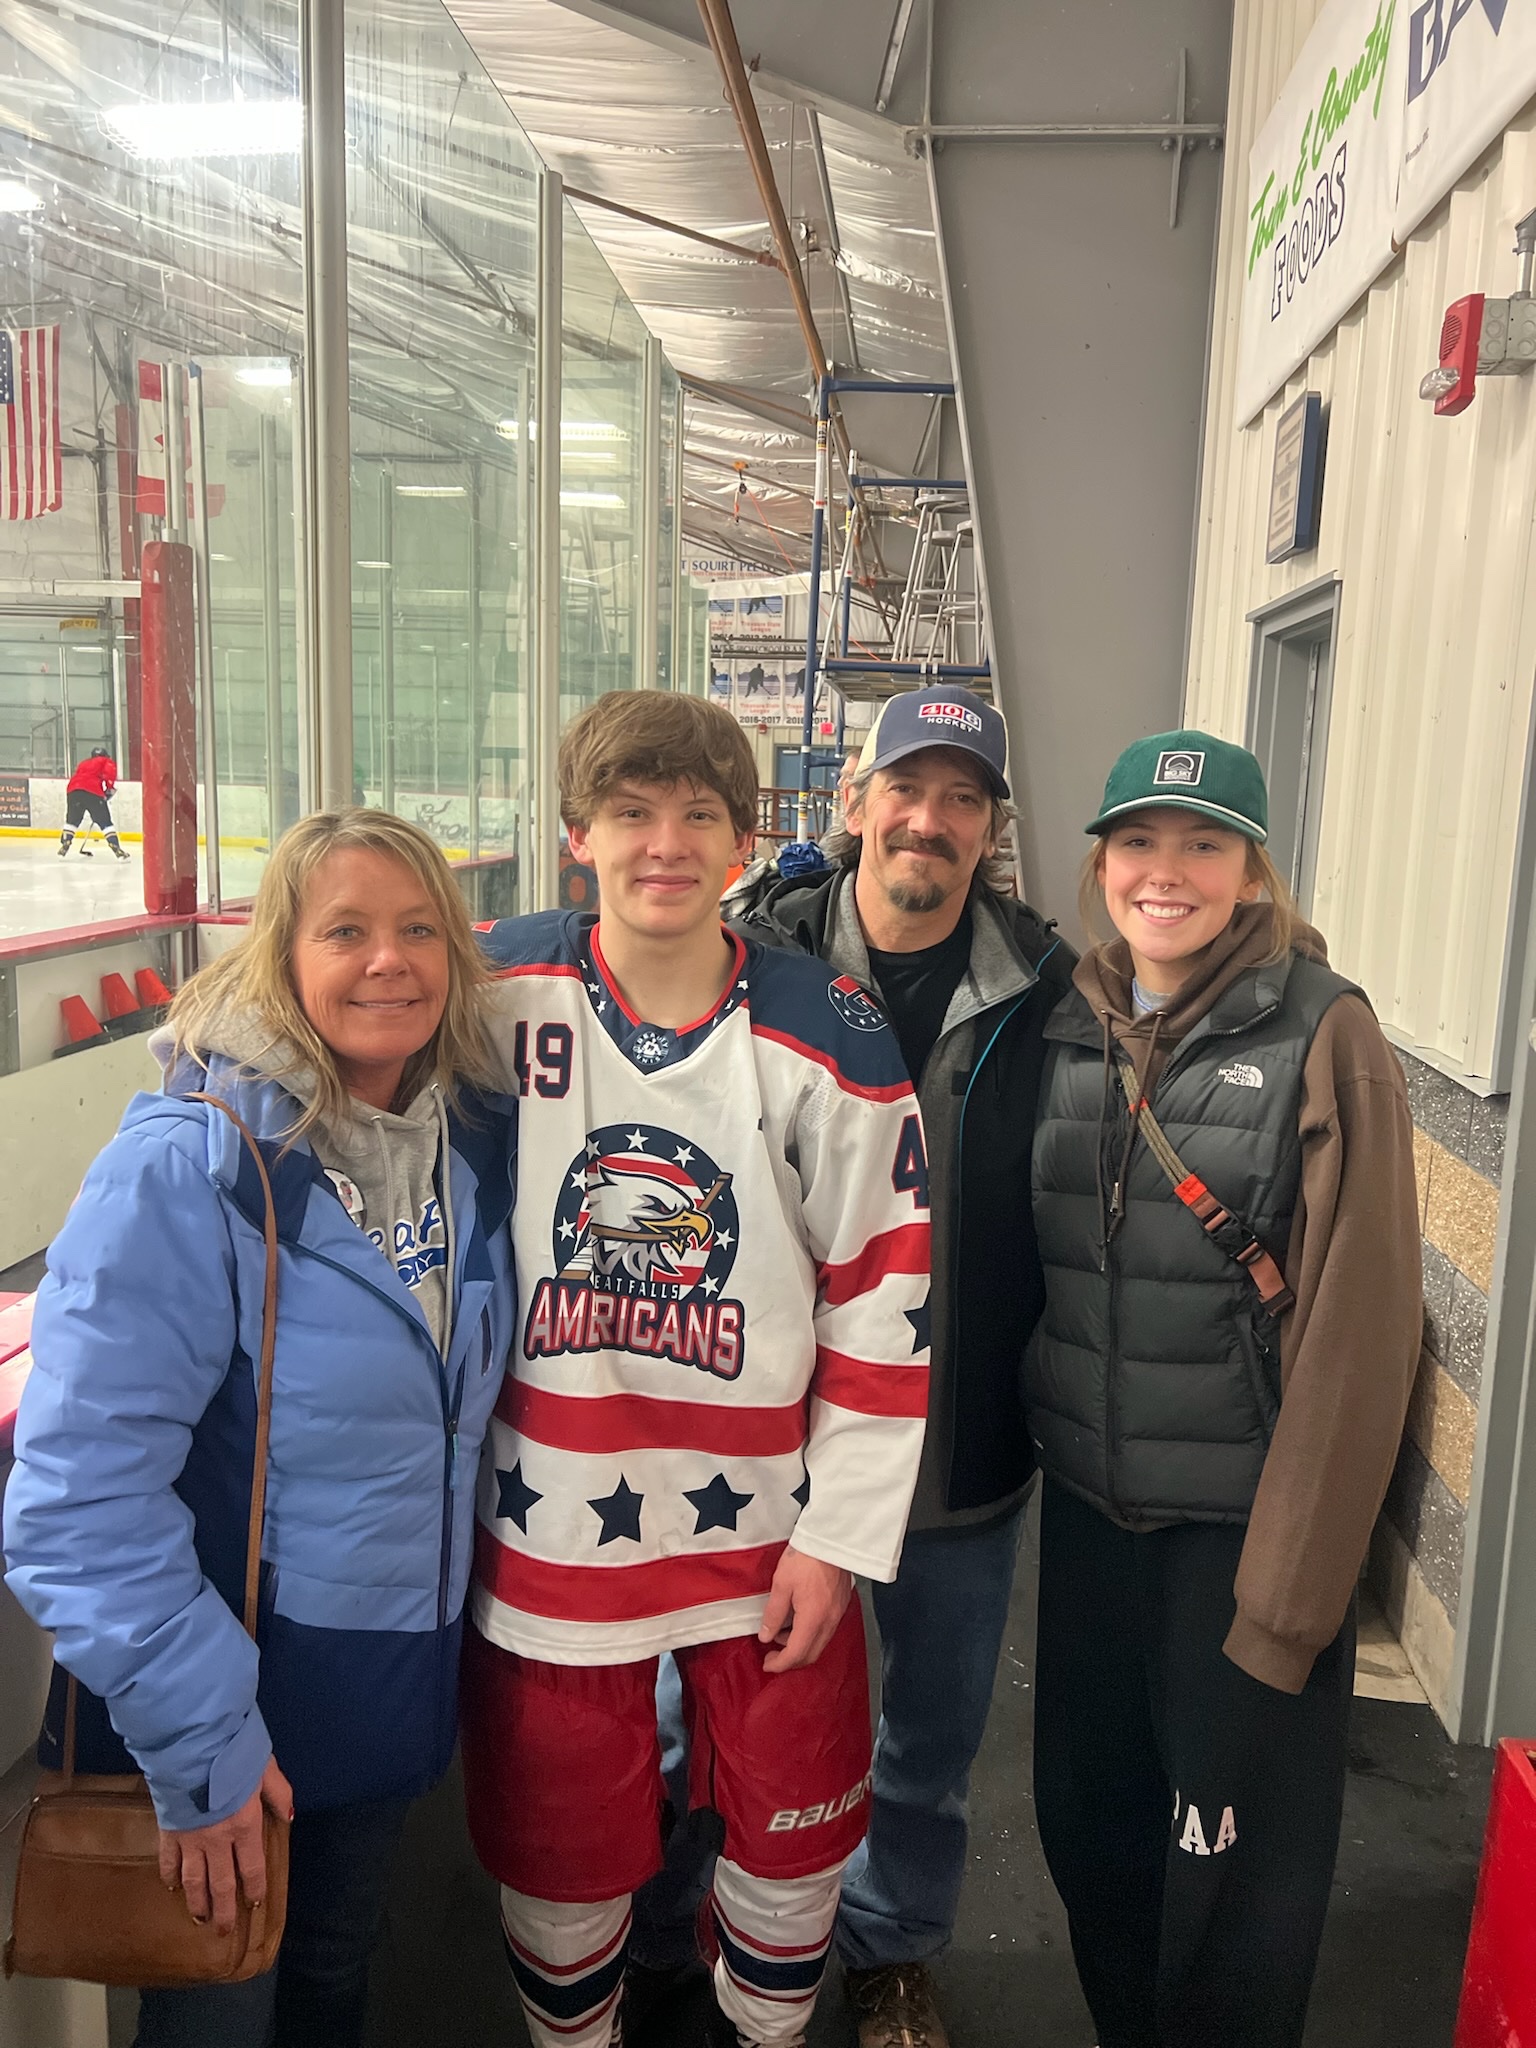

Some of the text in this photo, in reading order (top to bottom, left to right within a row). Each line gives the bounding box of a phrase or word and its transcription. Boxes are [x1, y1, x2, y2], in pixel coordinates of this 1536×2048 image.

[1248, 169, 1289, 280] Town
[1271, 140, 1348, 322] FOODS
[692, 560, 736, 572] SQUIRT
[927, 717, 973, 732] HOCKEY
[1233, 1063, 1251, 1072] THE
[1218, 1069, 1249, 1080] NORTH
[1223, 1077, 1249, 1087] FACE
[627, 1280, 679, 1299] FALLS
